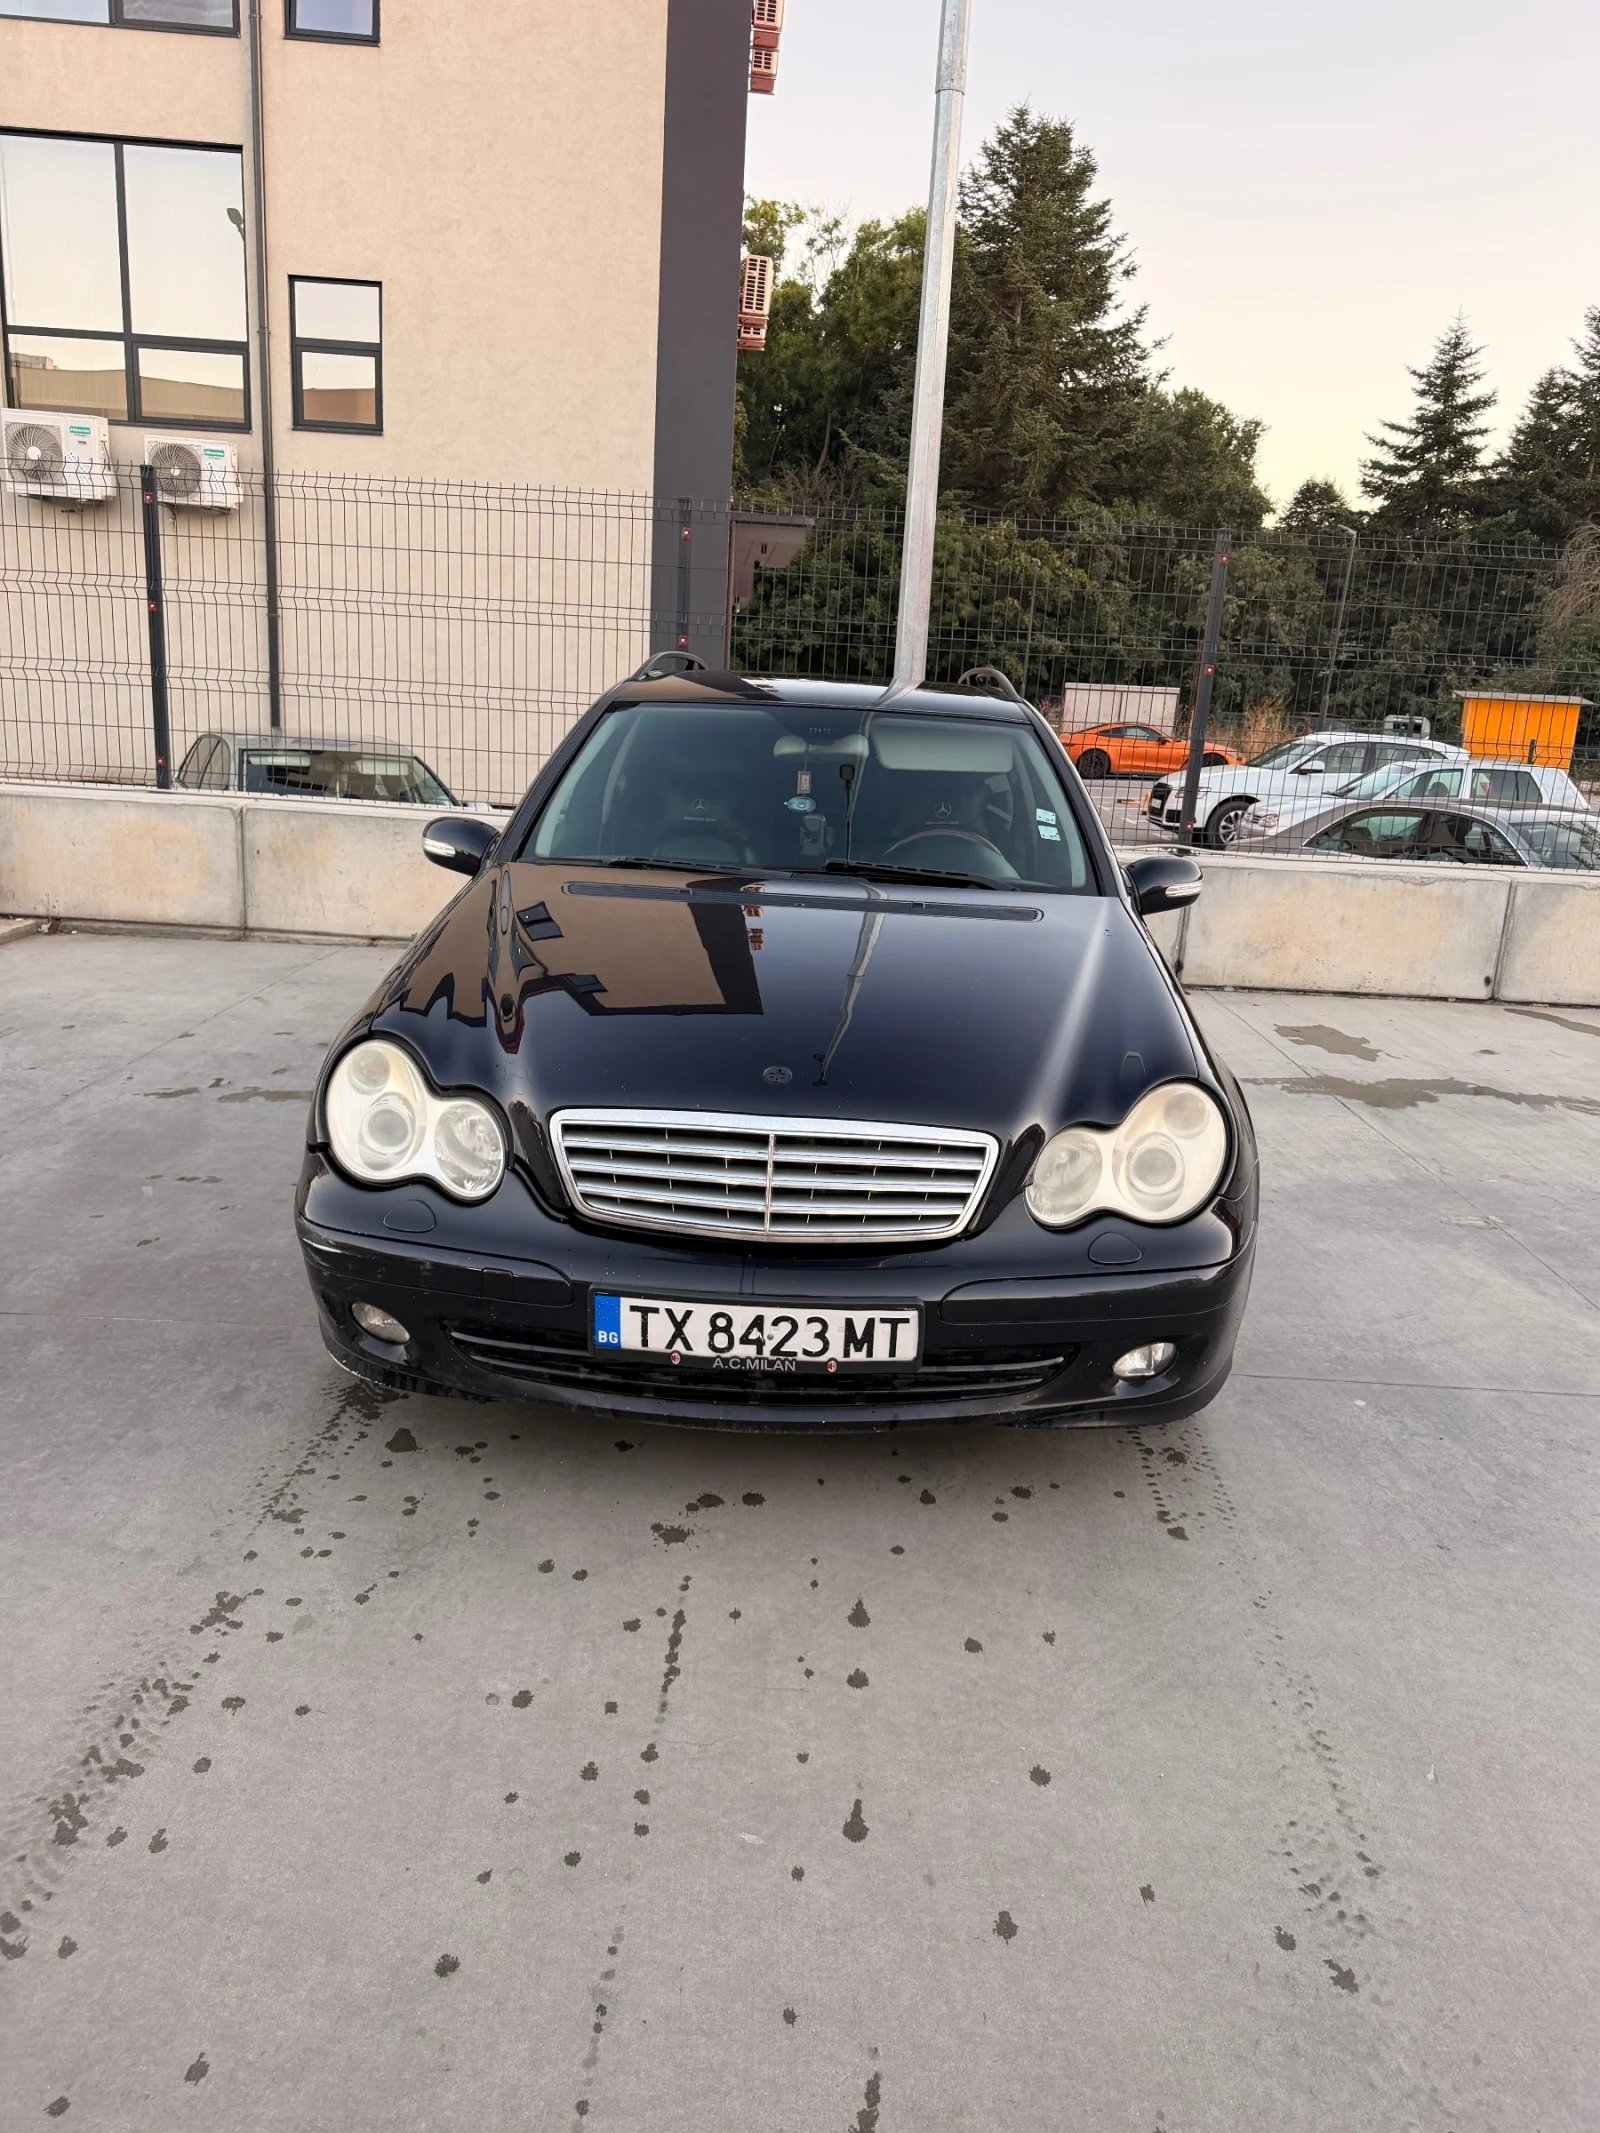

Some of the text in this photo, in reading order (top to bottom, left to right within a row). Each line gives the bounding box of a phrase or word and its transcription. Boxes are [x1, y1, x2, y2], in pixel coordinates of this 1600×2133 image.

[598, 1330, 618, 1344] BG
[629, 1305, 910, 1358] TX 8423 MT
